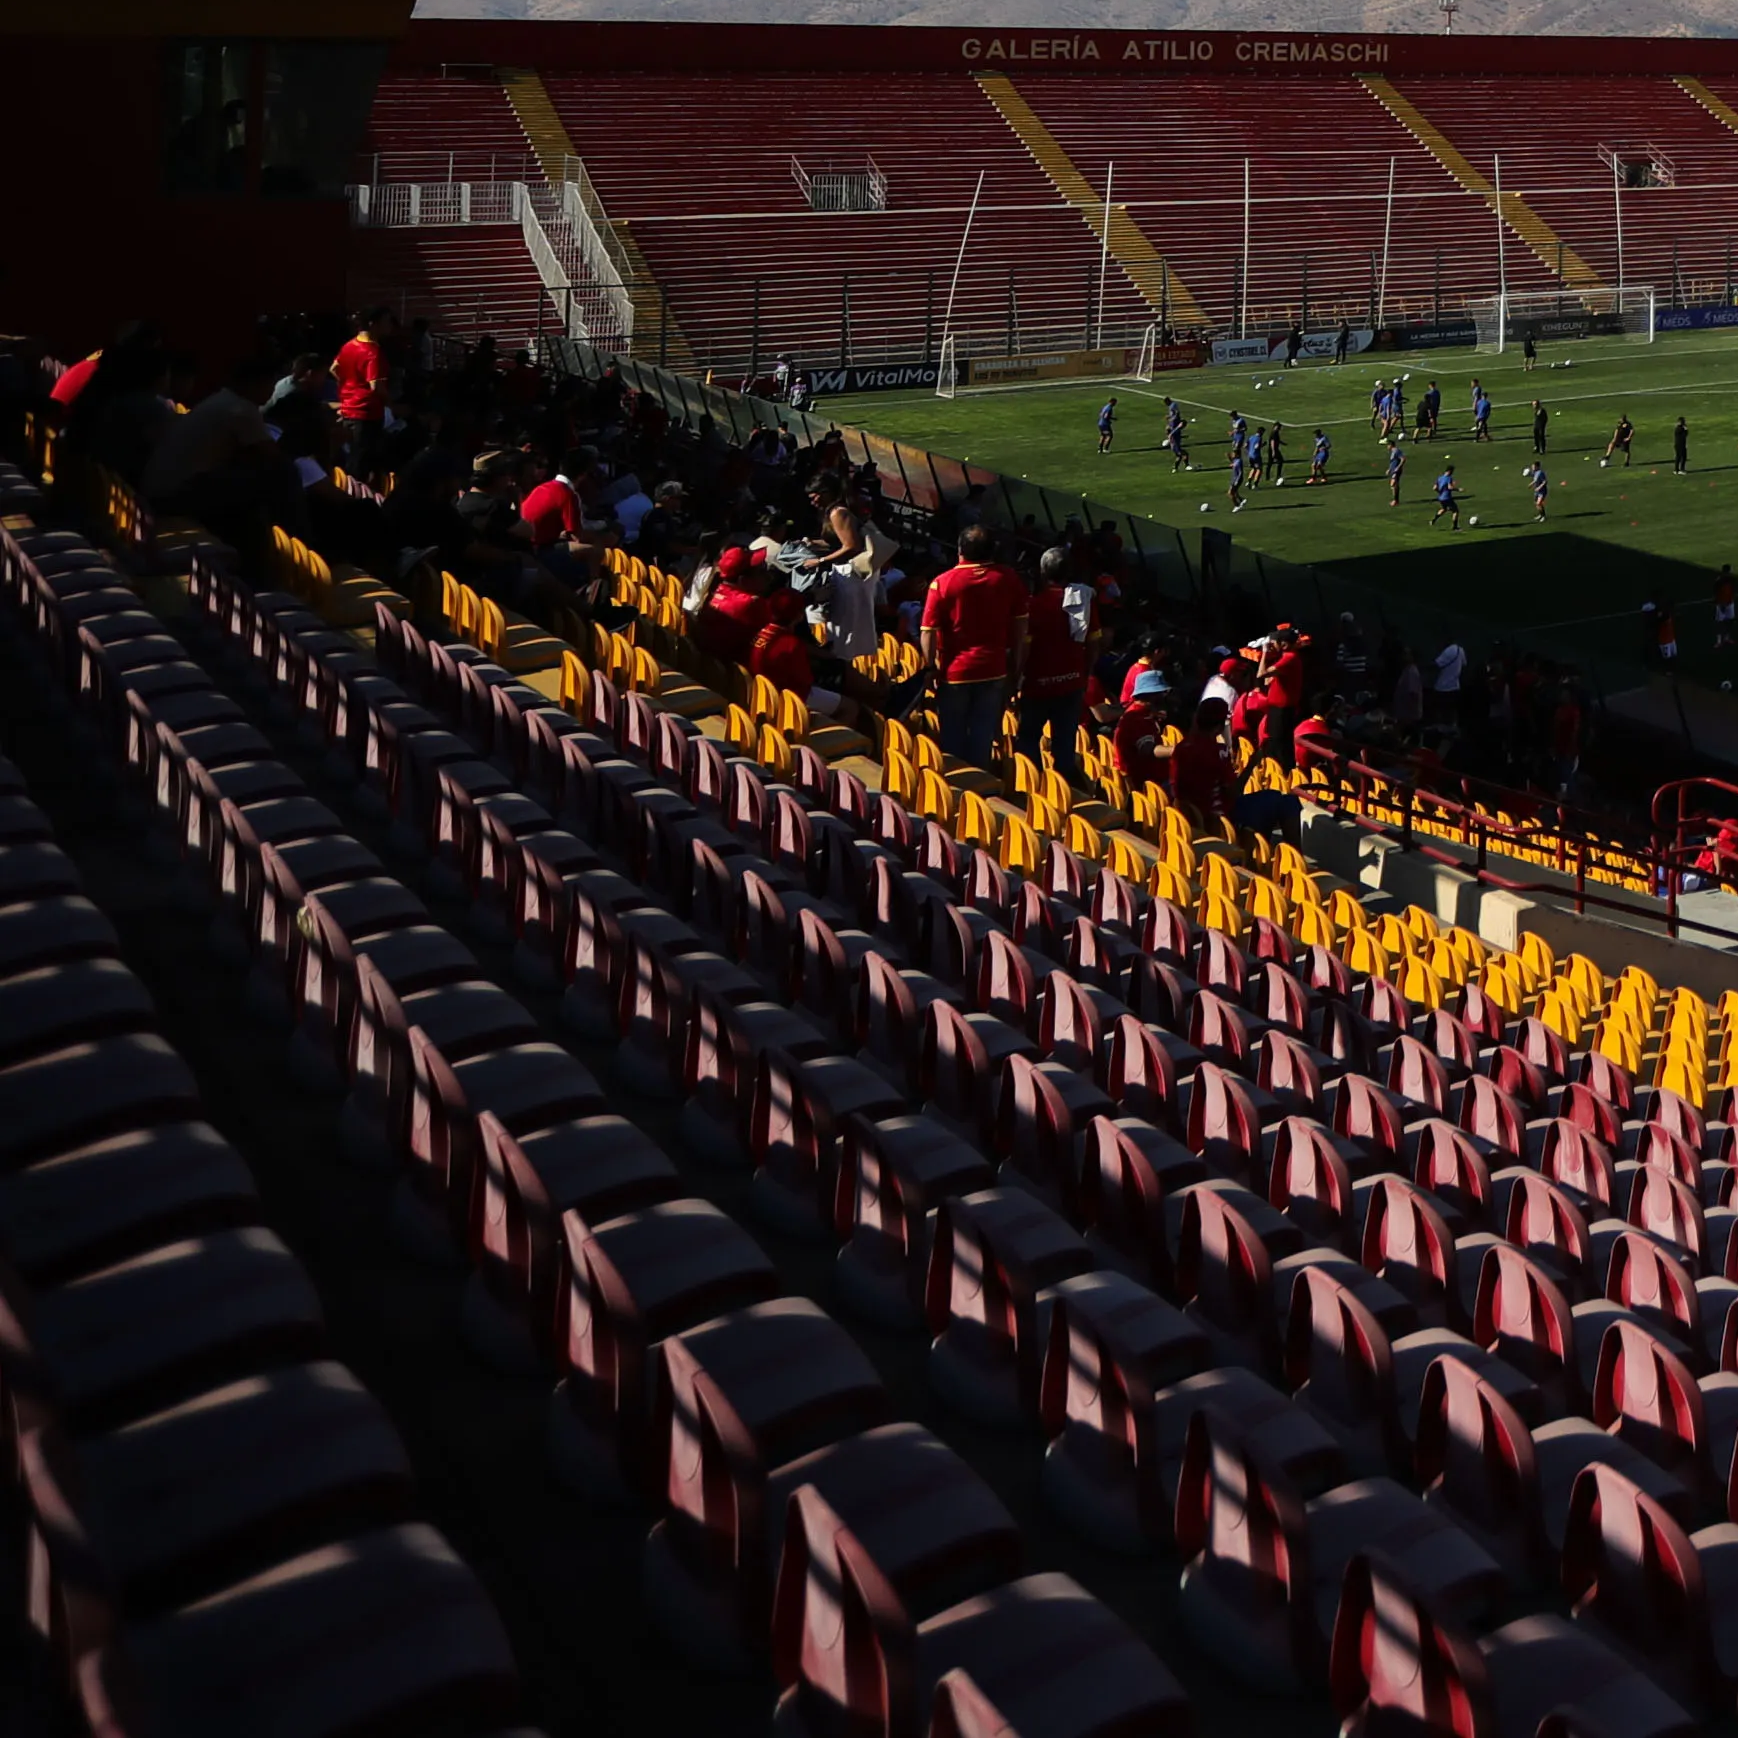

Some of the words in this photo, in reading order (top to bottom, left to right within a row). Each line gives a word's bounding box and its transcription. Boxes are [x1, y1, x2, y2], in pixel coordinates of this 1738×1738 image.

[961, 35, 1100, 60] GALERÍA
[1122, 40, 1214, 61] ATILIO
[1235, 42, 1389, 63] CREMASCHI
[1662, 317, 1692, 327] MEDS
[855, 366, 960, 389] VitalMove
